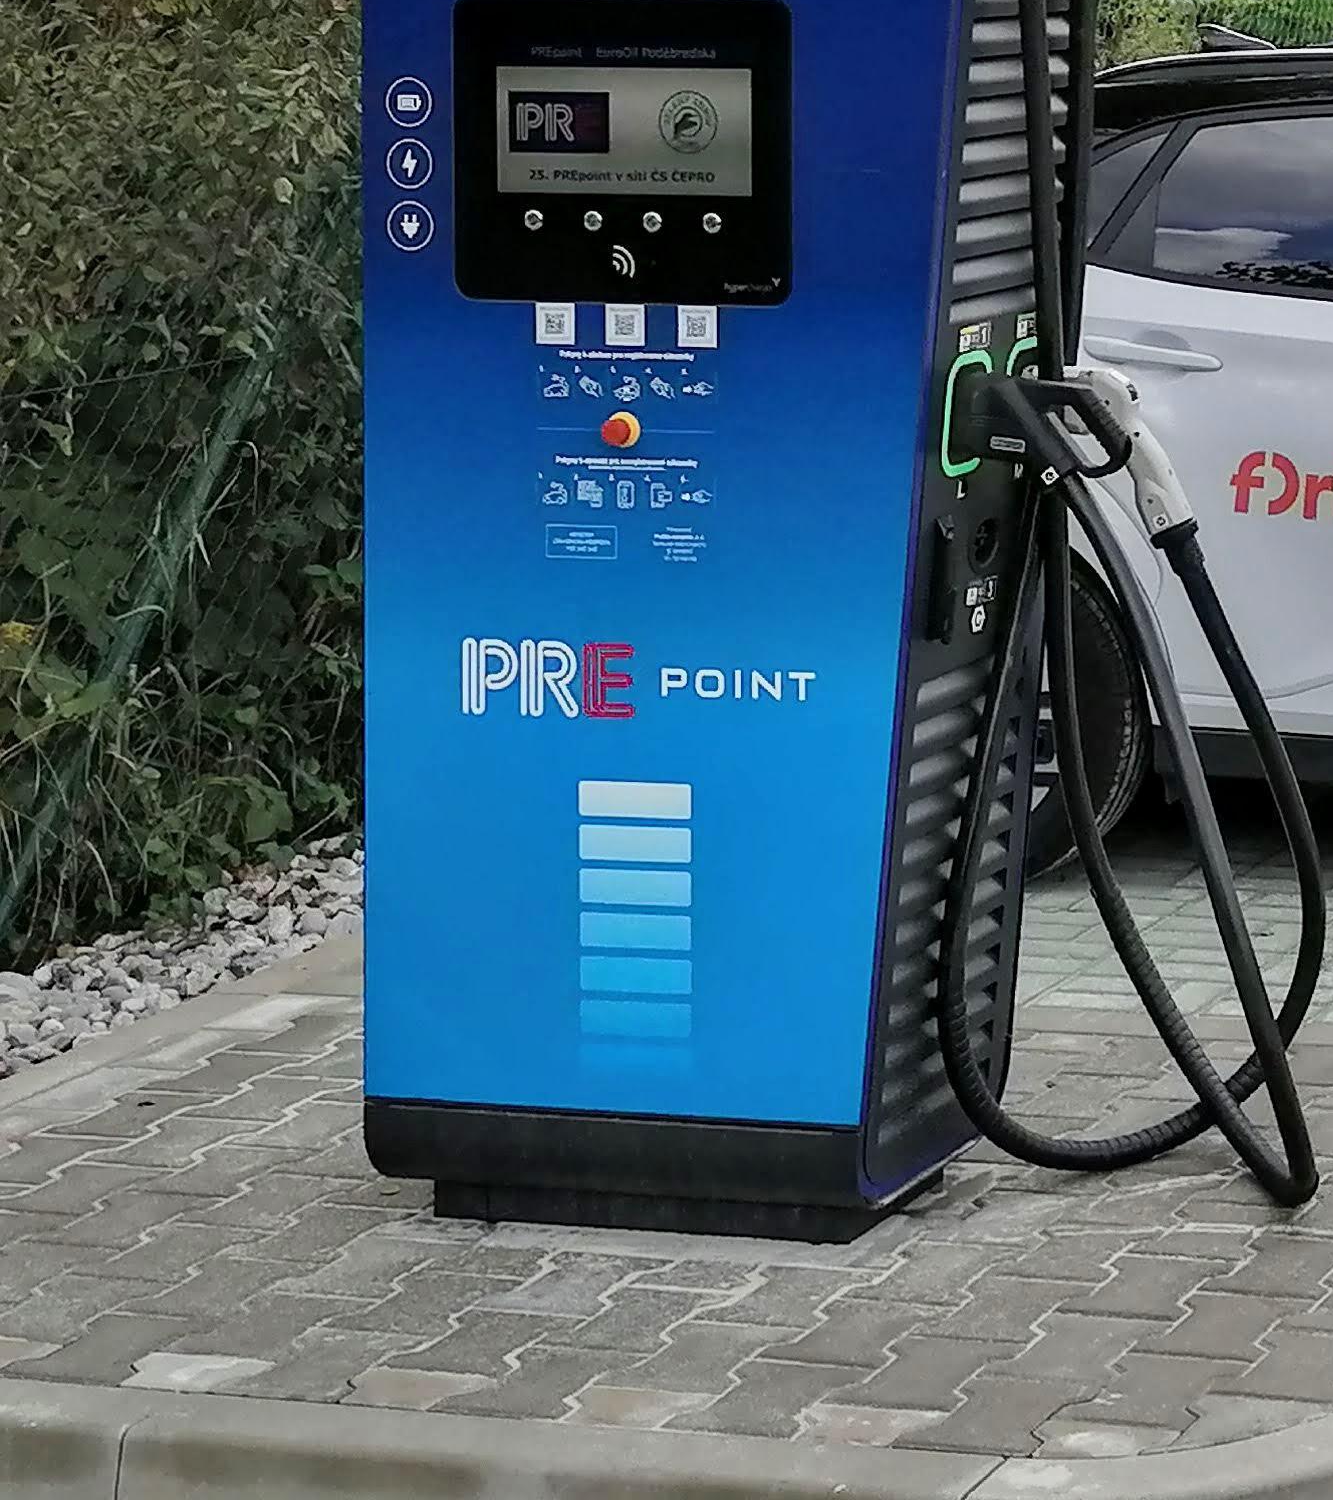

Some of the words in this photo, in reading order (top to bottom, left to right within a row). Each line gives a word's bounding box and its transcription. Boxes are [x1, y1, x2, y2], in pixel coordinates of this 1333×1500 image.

[553, 169, 612, 184] PREpoint
[671, 167, 716, 184] ČEPRO
[461, 637, 635, 719] PRE
[659, 666, 817, 702] POINT
